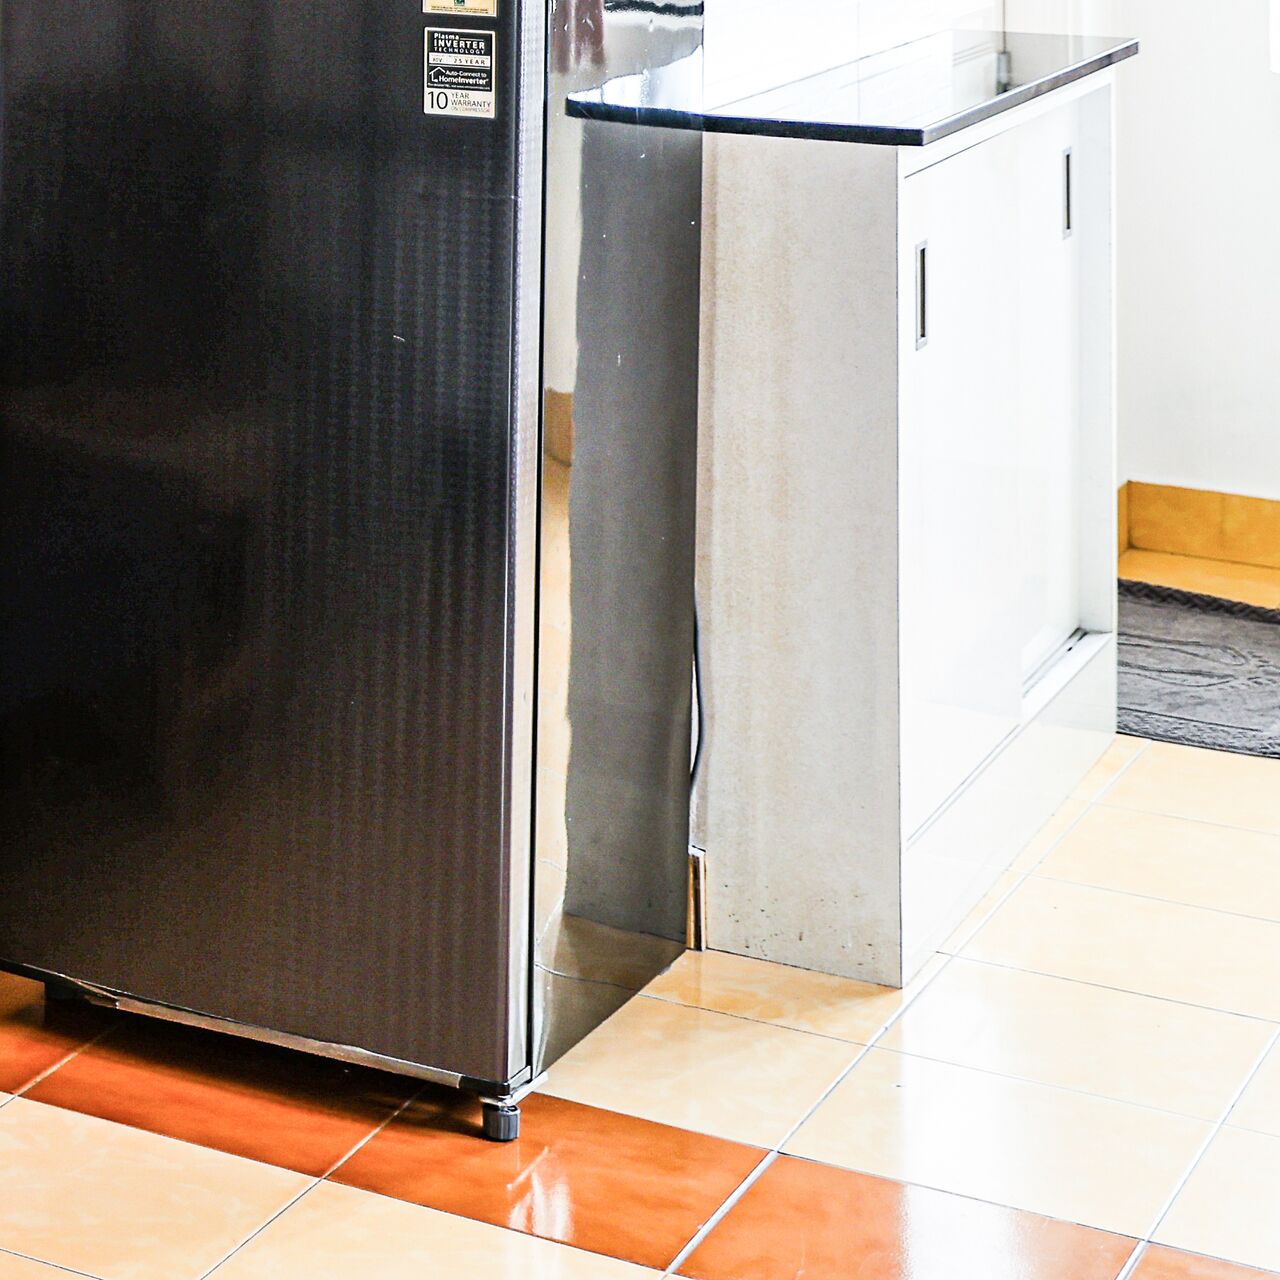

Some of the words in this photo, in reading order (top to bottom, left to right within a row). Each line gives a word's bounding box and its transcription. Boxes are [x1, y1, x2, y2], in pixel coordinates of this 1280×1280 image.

[433, 32, 460, 40] Plasma
[433, 39, 485, 49] INVERTER
[434, 46, 485, 55] TECHNOLOGY
[427, 91, 448, 110] 10
[450, 99, 492, 108] WARRANTY
